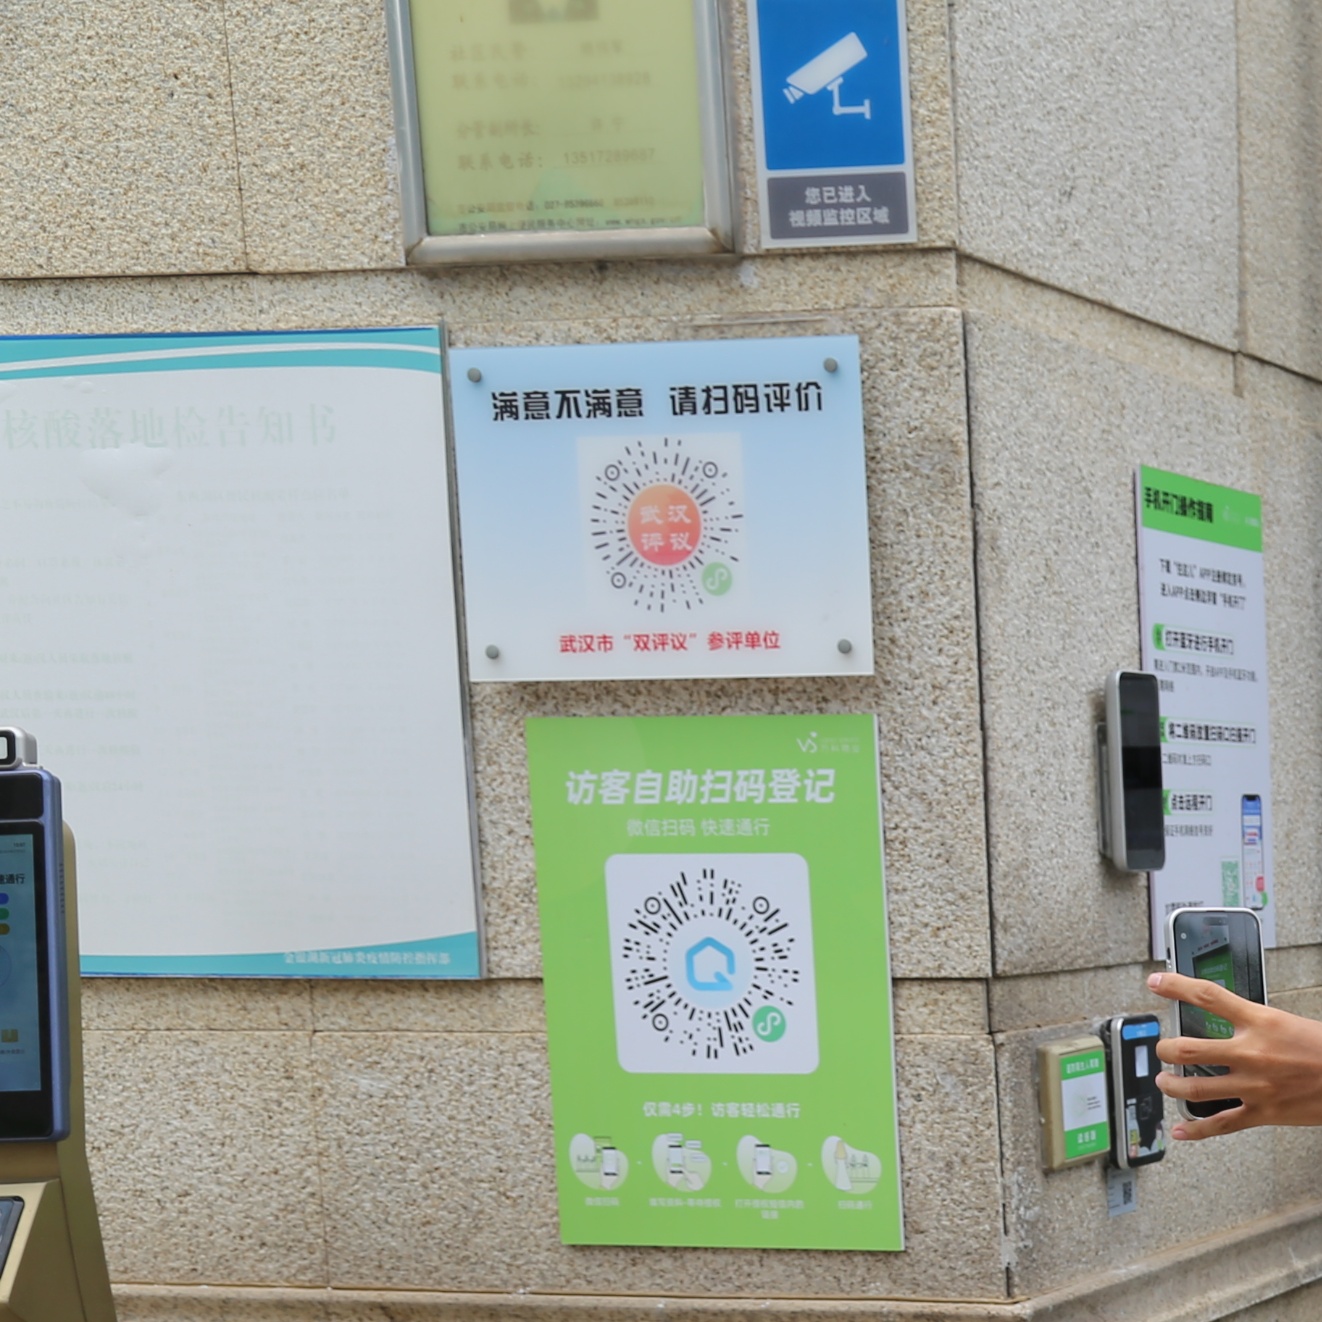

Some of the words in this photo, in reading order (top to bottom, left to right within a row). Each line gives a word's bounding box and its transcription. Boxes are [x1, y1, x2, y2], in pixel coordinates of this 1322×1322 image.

[805, 185, 871, 204] 您已进入
[789, 206, 890, 227] 视频监控区域
[491, 388, 645, 421] 满意不满意
[669, 381, 824, 416] 请扫码评价
[640, 504, 692, 525] 武汉
[640, 532, 693, 552] 评议
[566, 768, 836, 805] 访客自助扫码登记
[627, 818, 697, 838] 微信扫码
[701, 818, 771, 838] 快速通行
[643, 1102, 703, 1118] 仅需4步！
[711, 1102, 801, 1119] 访客轻松通行
